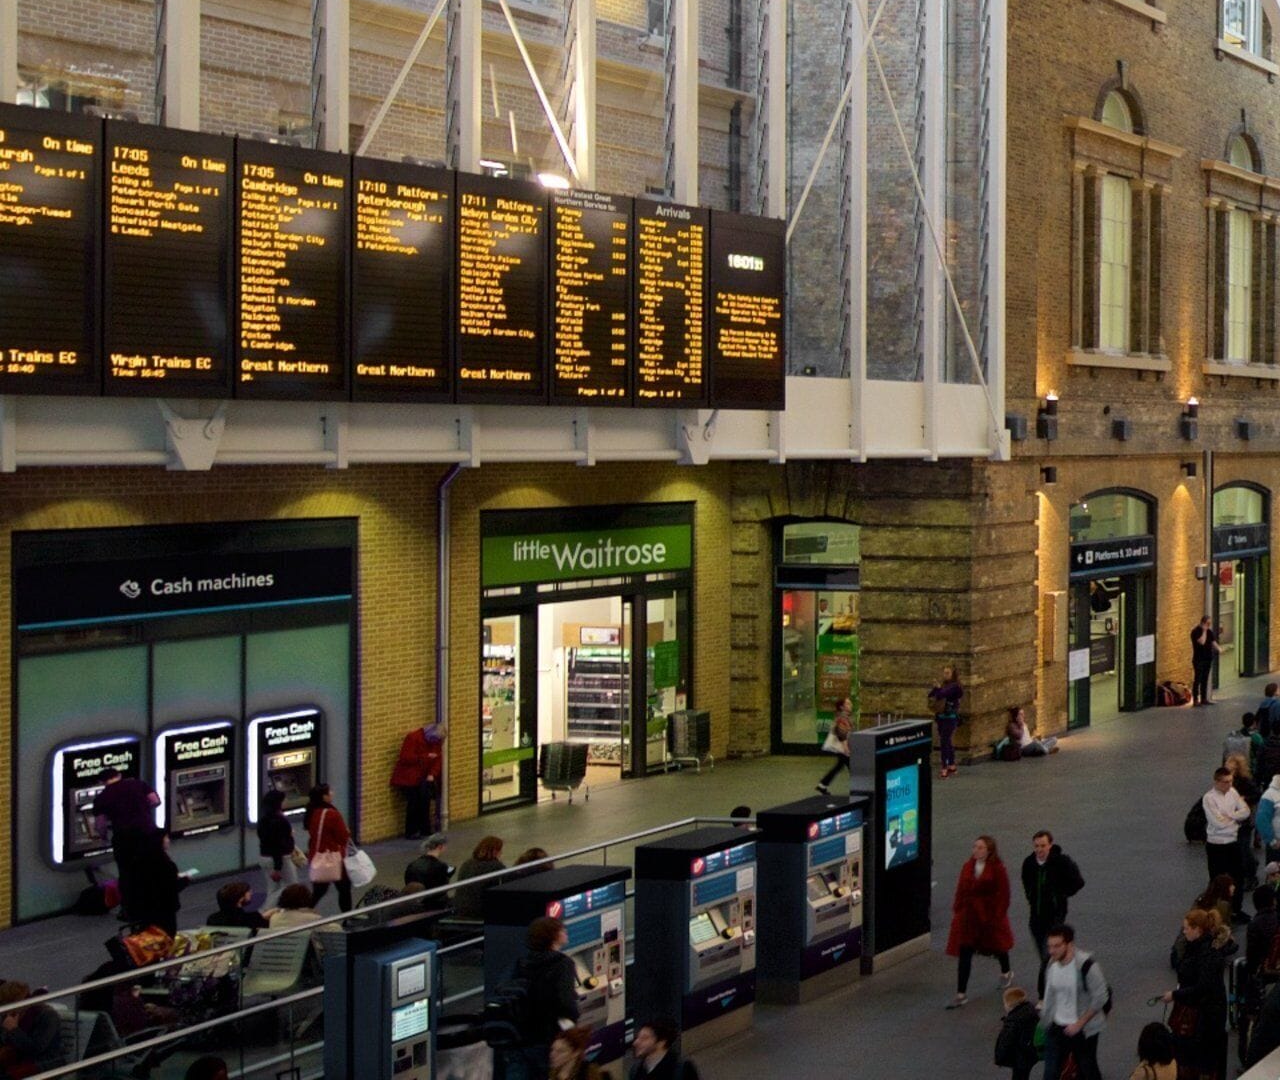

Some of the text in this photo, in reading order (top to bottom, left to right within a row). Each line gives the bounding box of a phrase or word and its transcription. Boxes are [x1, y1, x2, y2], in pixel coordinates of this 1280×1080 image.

[43, 137, 93, 154] On time
[113, 146, 226, 173] 17:05 On time
[111, 161, 150, 177] Leeds
[243, 164, 344, 189] 17:05 On time
[111, 185, 177, 201] Peterborough
[242, 178, 298, 196] Cambridge
[359, 180, 387, 194] 17:10
[462, 194, 486, 208] 17:11
[656, 205, 691, 220] Arrivals
[9, 350, 77, 364] Trains EC
[111, 354, 211, 369] Virgin Trains EC
[241, 359, 329, 374] Great Northern
[356, 363, 436, 378] Great Northern
[460, 368, 532, 381] Great Northern
[513, 537, 666, 570] little Waitrose
[1094, 550, 1120, 561] Platforms
[151, 573, 274, 595] Cash machines
[265, 721, 315, 739] Free Cash
[174, 735, 228, 753] Free Cash
[73, 751, 133, 770] Free Cash
